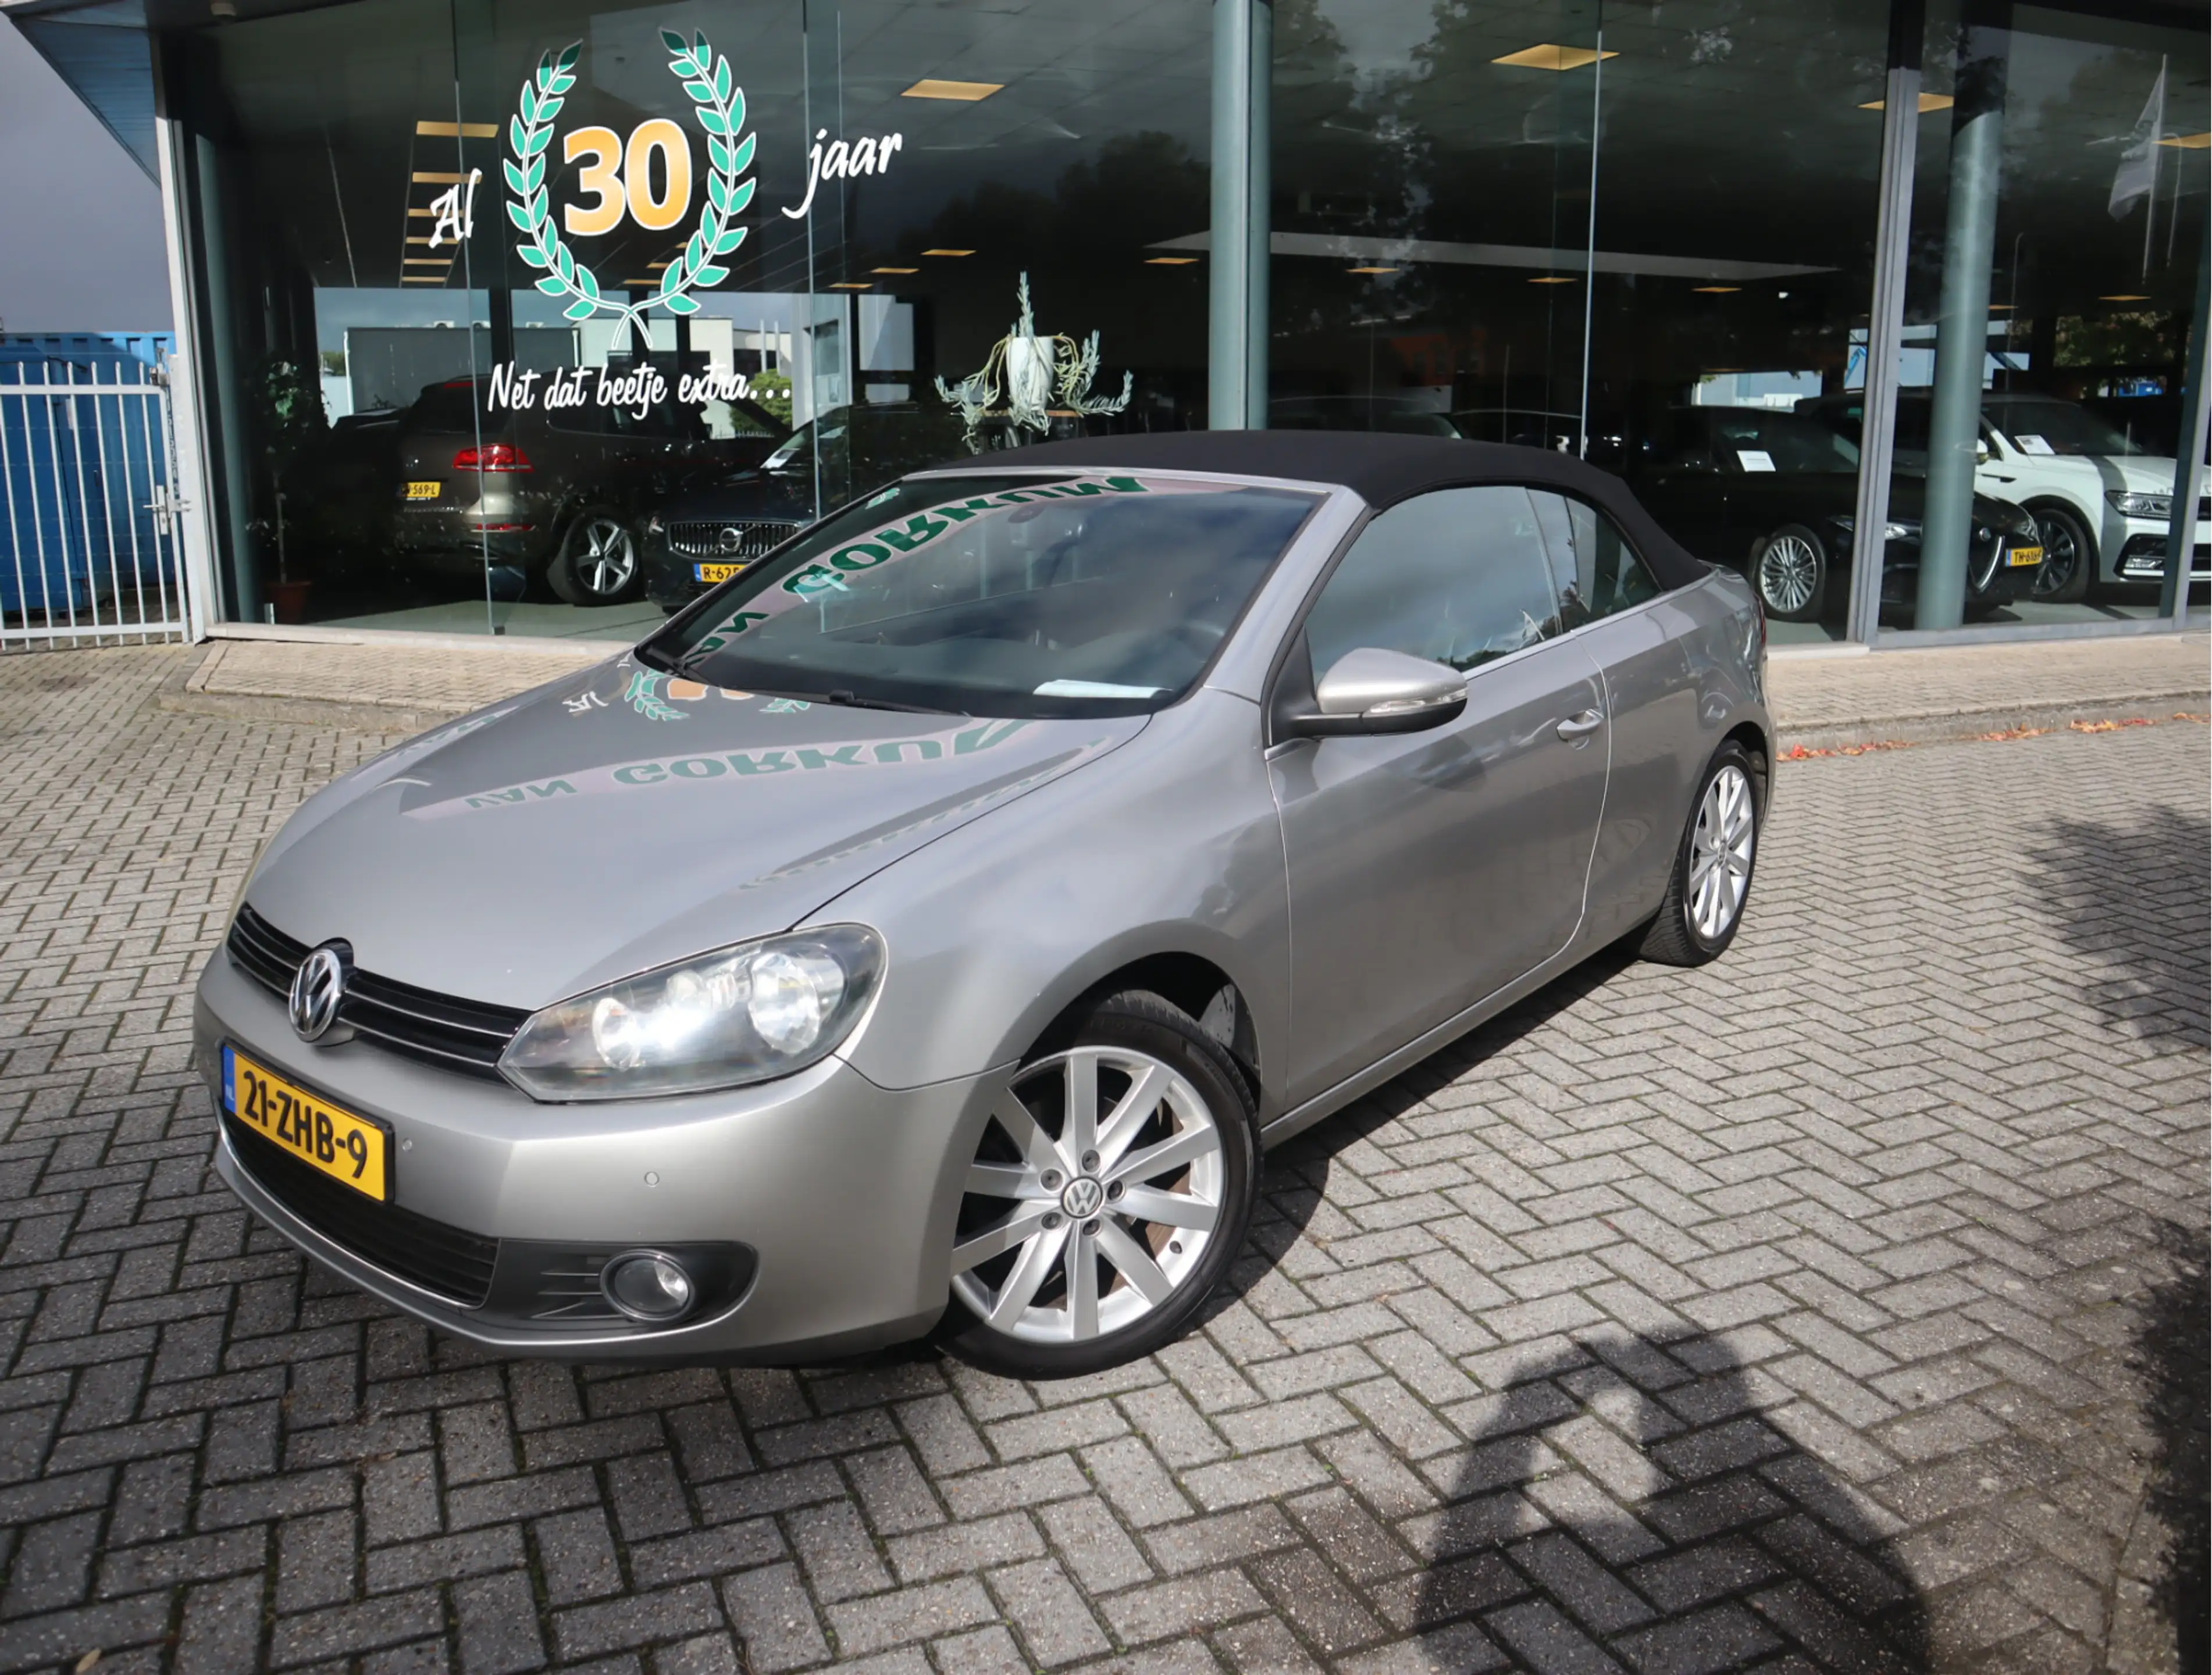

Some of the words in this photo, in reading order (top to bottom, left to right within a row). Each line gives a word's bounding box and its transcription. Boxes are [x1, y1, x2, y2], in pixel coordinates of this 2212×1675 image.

[428, 168, 482, 249] Al
[564, 118, 692, 236] 30
[781, 128, 902, 219] jaar
[487, 361, 541, 412] Net
[544, 365, 593, 410] dat
[597, 362, 668, 420] beetje
[243, 1070, 368, 1179] 21-ZHB-9
